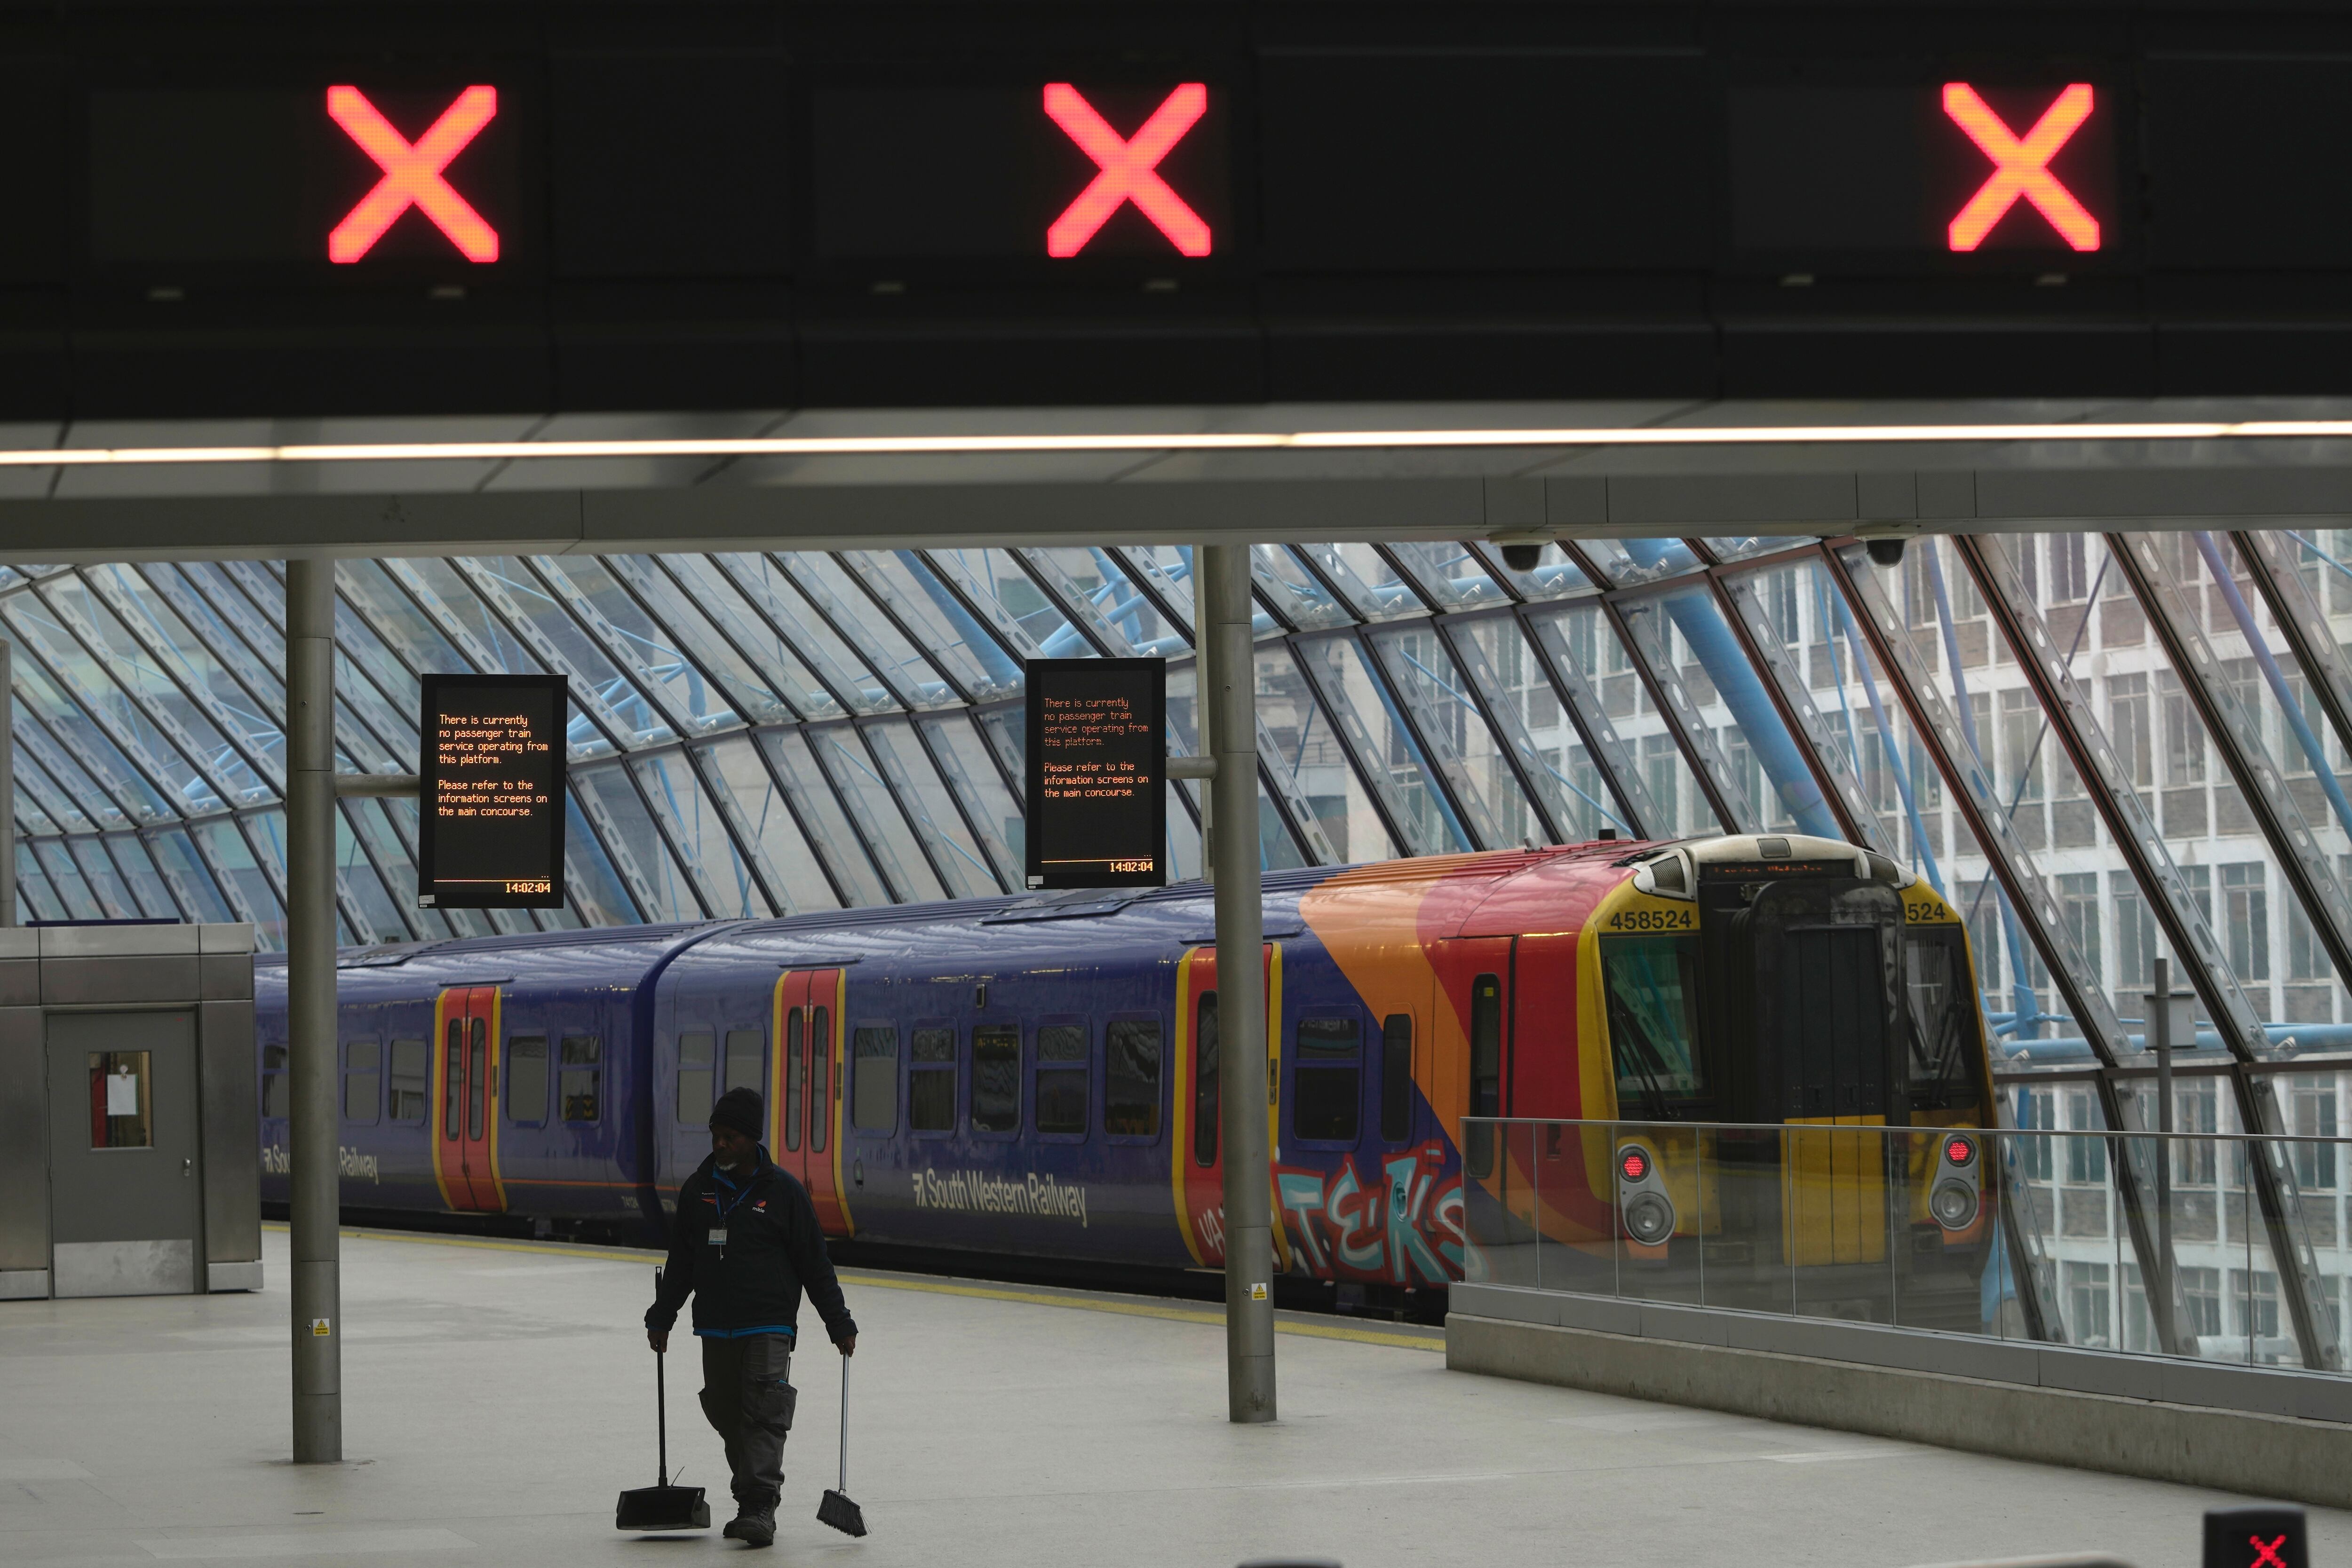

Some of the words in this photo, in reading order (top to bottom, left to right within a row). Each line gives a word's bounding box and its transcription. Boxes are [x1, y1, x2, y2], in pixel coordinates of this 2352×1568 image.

[1044, 698, 1071, 708] There
[1074, 698, 1082, 707] is
[1086, 697, 1128, 710] currently
[439, 714, 467, 725] There
[471, 715, 479, 725] is
[483, 714, 528, 727] currently
[1059, 713, 1106, 723] passenger
[1110, 711, 1132, 720] train
[454, 729, 504, 741] passenger
[508, 728, 531, 738] train
[1044, 725, 1077, 734] service
[1081, 724, 1124, 736] operating
[1128, 722, 1148, 732] from
[439, 741, 474, 751] service
[477, 741, 523, 754] operating
[527, 740, 548, 751] from
[1044, 737, 1061, 746] this
[439, 753, 457, 764] this
[461, 754, 502, 767] platform.
[1044, 762, 1073, 772] Please
[1076, 761, 1102, 771] refer
[1106, 762, 1116, 771] to
[1120, 761, 1135, 771] the
[438, 779, 469, 790] Please
[472, 780, 499, 790] refer
[503, 780, 514, 790] to
[517, 779, 533, 790] the
[1044, 775, 1093, 785] information
[438, 792, 490, 803] information
[493, 795, 532, 804] screens
[1044, 788, 1060, 798] the
[1063, 788, 1081, 798] main
[1085, 789, 1135, 797] concourse.
[438, 806, 454, 816] the
[458, 807, 477, 816] main
[480, 808, 533, 816] concourse.
[1110, 862, 1153, 872] 14:02:04
[506, 883, 551, 893] 14:02:04
[1610, 910, 1692, 930] 458524
[339, 1146, 379, 1185] Railway
[927, 1167, 968, 1209] South
[967, 1170, 1030, 1214] Western
[1027, 1172, 1088, 1228] Railway
